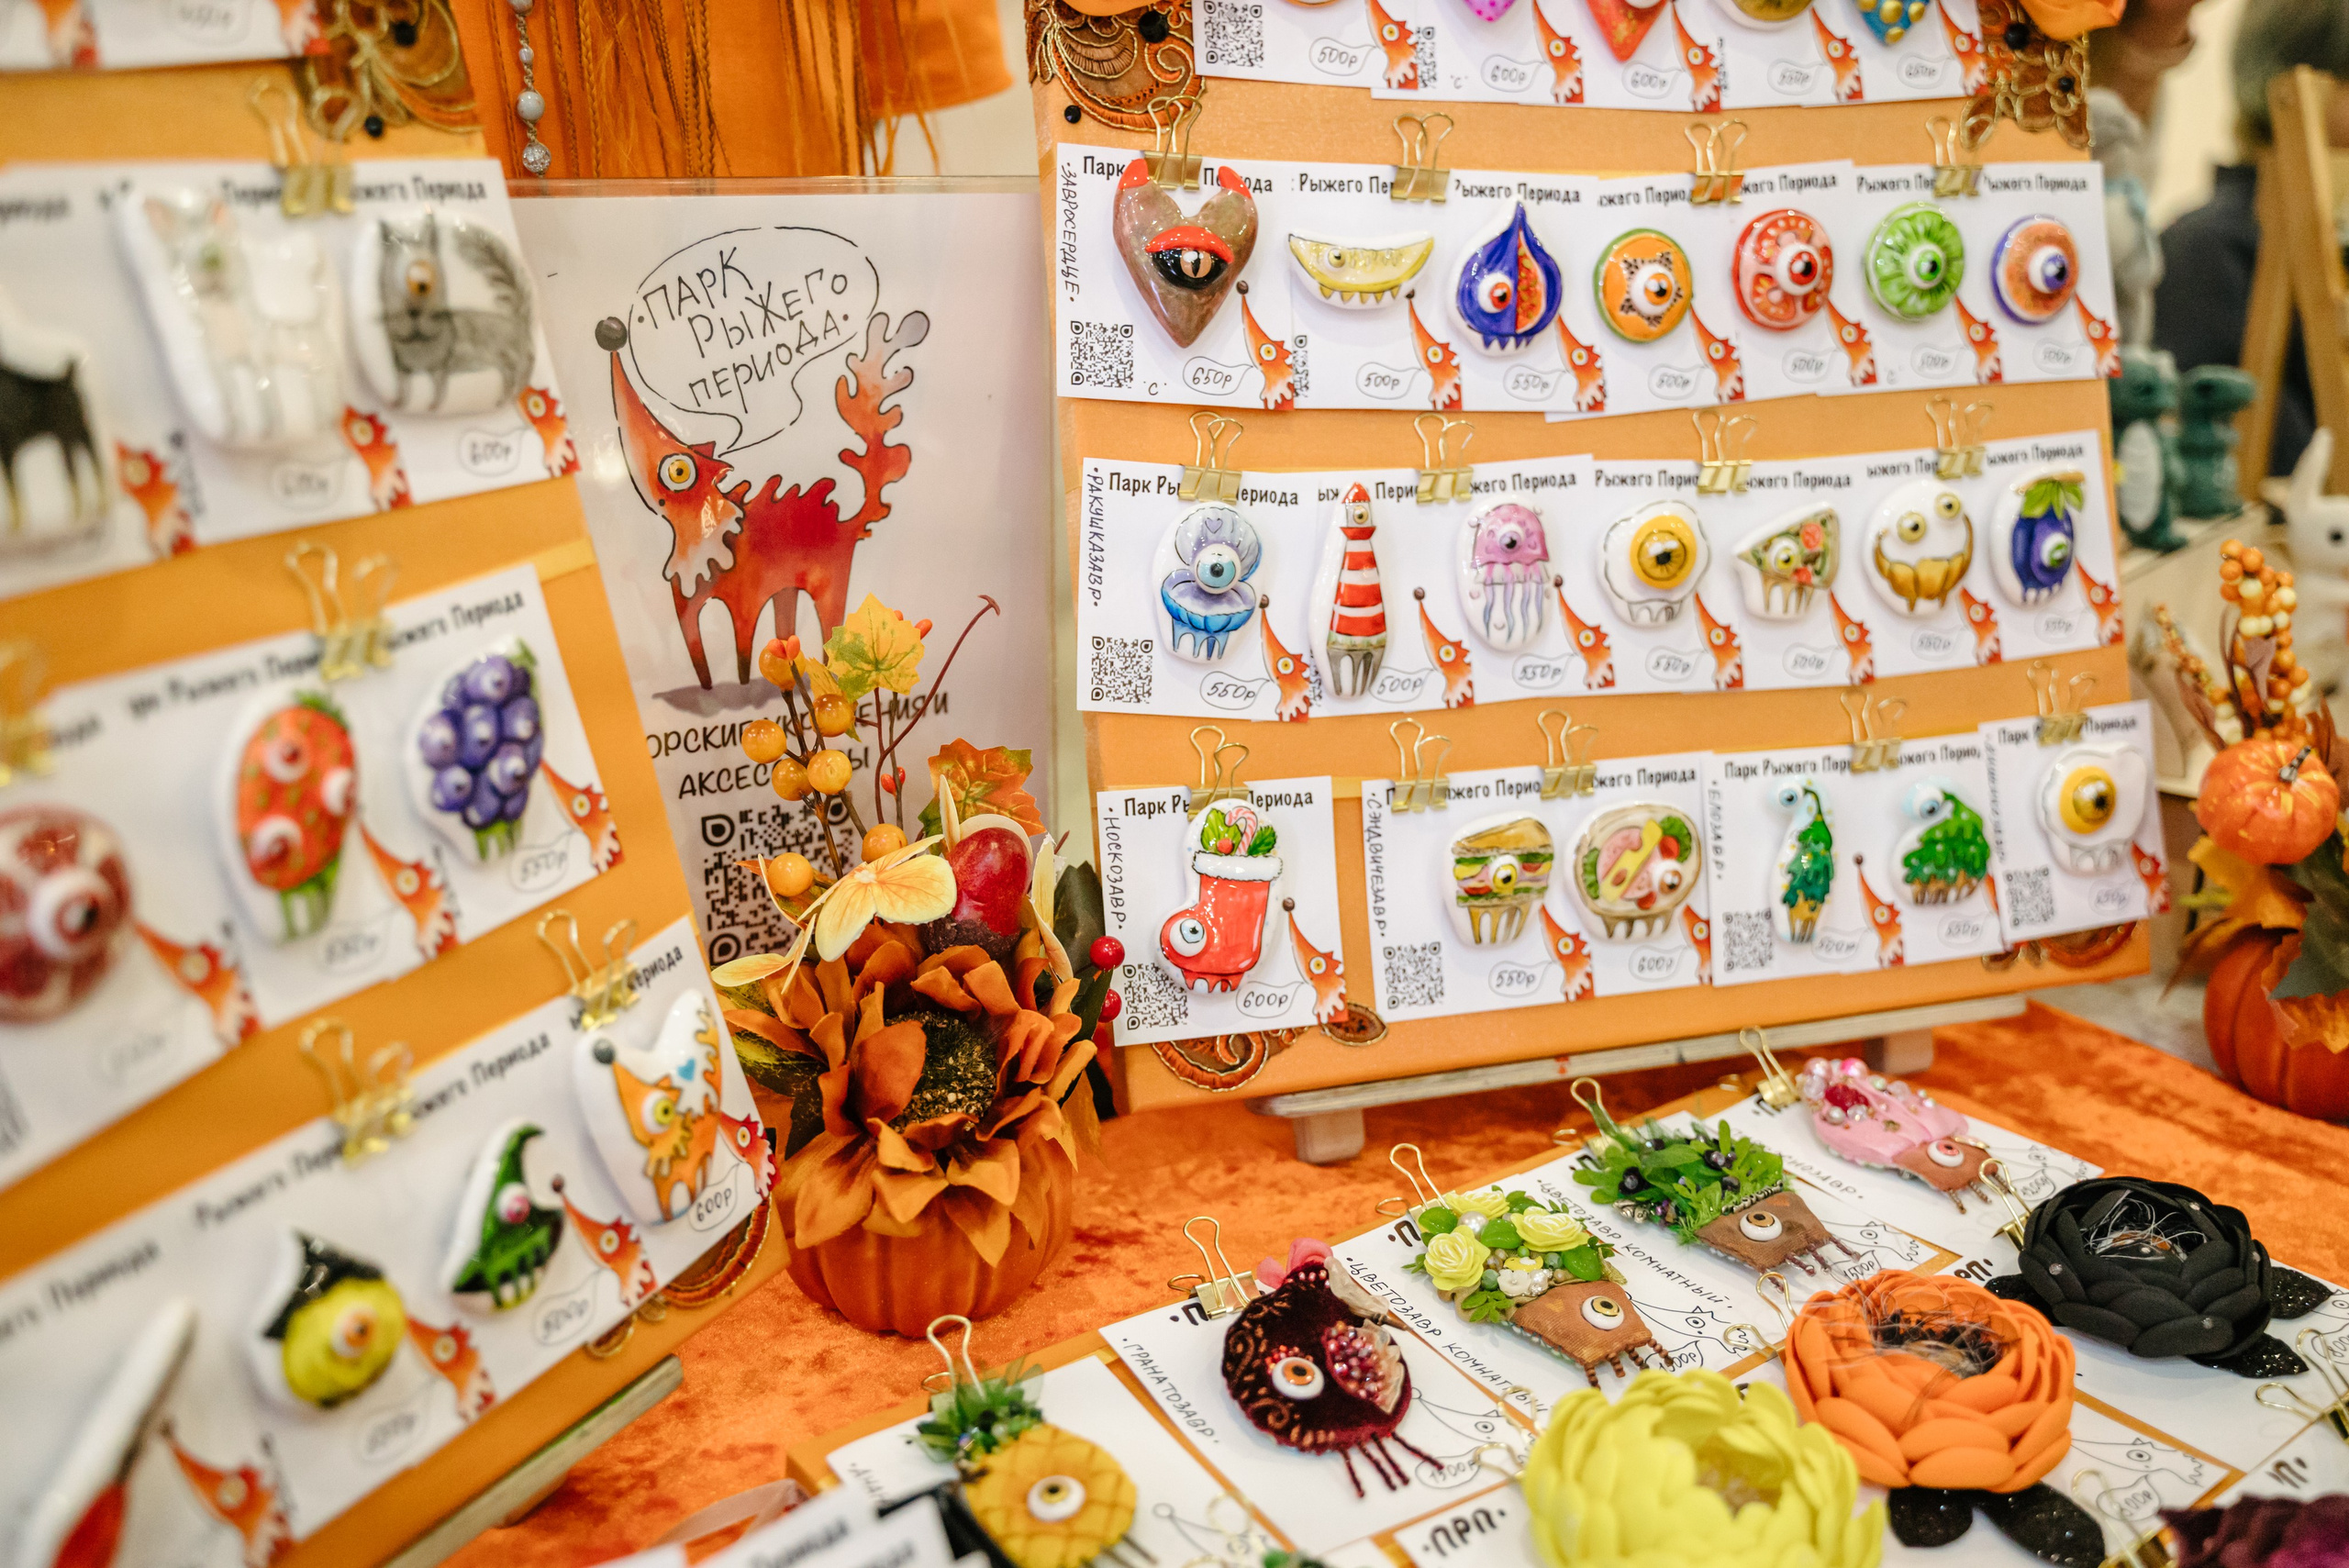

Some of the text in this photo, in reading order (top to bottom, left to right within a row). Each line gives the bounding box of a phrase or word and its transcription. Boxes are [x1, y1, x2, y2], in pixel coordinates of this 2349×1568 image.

[1299, 172, 1364, 194] Рыжего
[1517, 182, 1581, 205] Периода
[1778, 172, 1838, 193] Периода
[687, 268, 849, 359] РЫЖЕГО
[1192, 367, 1232, 390] 650р
[1363, 372, 1400, 392] 500р
[1108, 472, 1152, 496] Парк
[1236, 486, 1299, 506] ериода
[1512, 472, 1577, 495] Периода
[1595, 468, 1652, 488] Рыжего
[1207, 681, 1256, 700] 550р
[1636, 768, 1696, 789] Периода
[1724, 761, 1758, 783] Парк
[1124, 796, 1166, 820] Парк
[1495, 969, 1536, 988] 550р
[1242, 990, 1289, 1008] 600р
